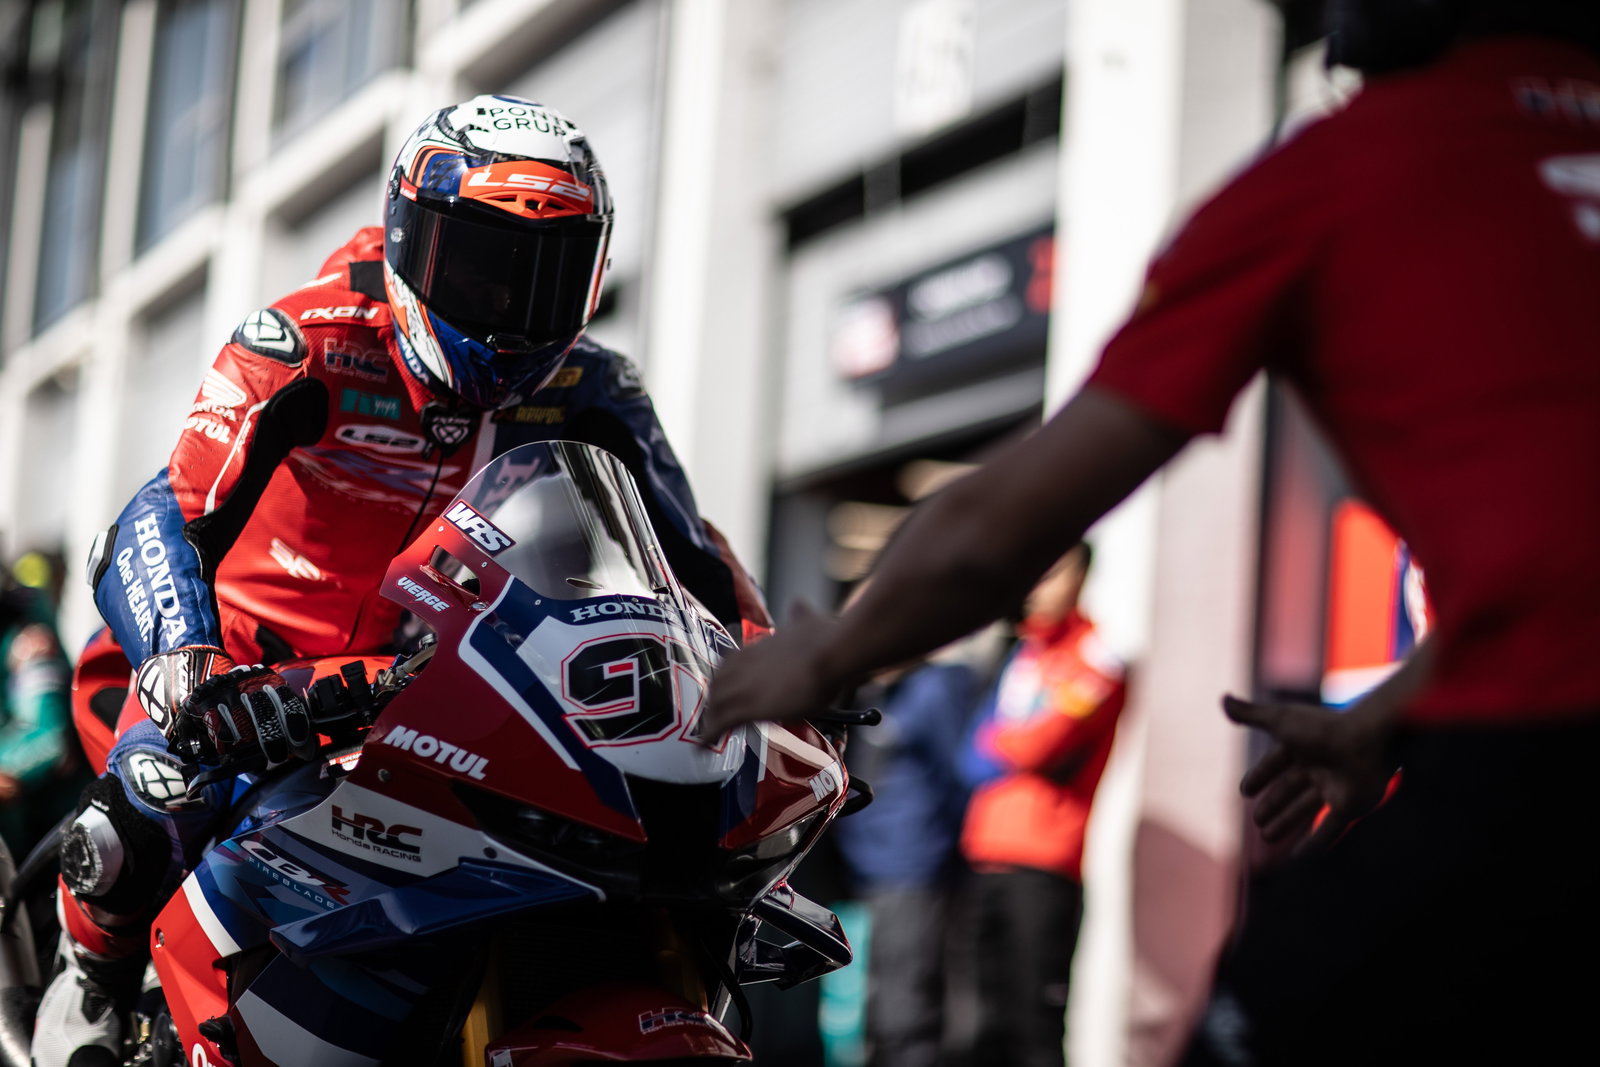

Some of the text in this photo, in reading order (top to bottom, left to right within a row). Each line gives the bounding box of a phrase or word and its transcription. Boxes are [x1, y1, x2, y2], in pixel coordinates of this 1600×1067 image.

[488, 106, 562, 126] PONT
[493, 116, 567, 136] GRUP
[467, 172, 590, 200] LS2
[300, 306, 379, 320] IXON
[341, 428, 419, 446] LS2
[444, 501, 511, 551] WRS
[116, 547, 155, 643] One HEART.
[135, 513, 187, 648] HONDA
[397, 576, 449, 612] VIERGE
[382, 725, 490, 780] MOTUL
[331, 804, 423, 854] HRC
[331, 829, 422, 862] Honda RACING
[248, 856, 336, 909] FIREBLADE
